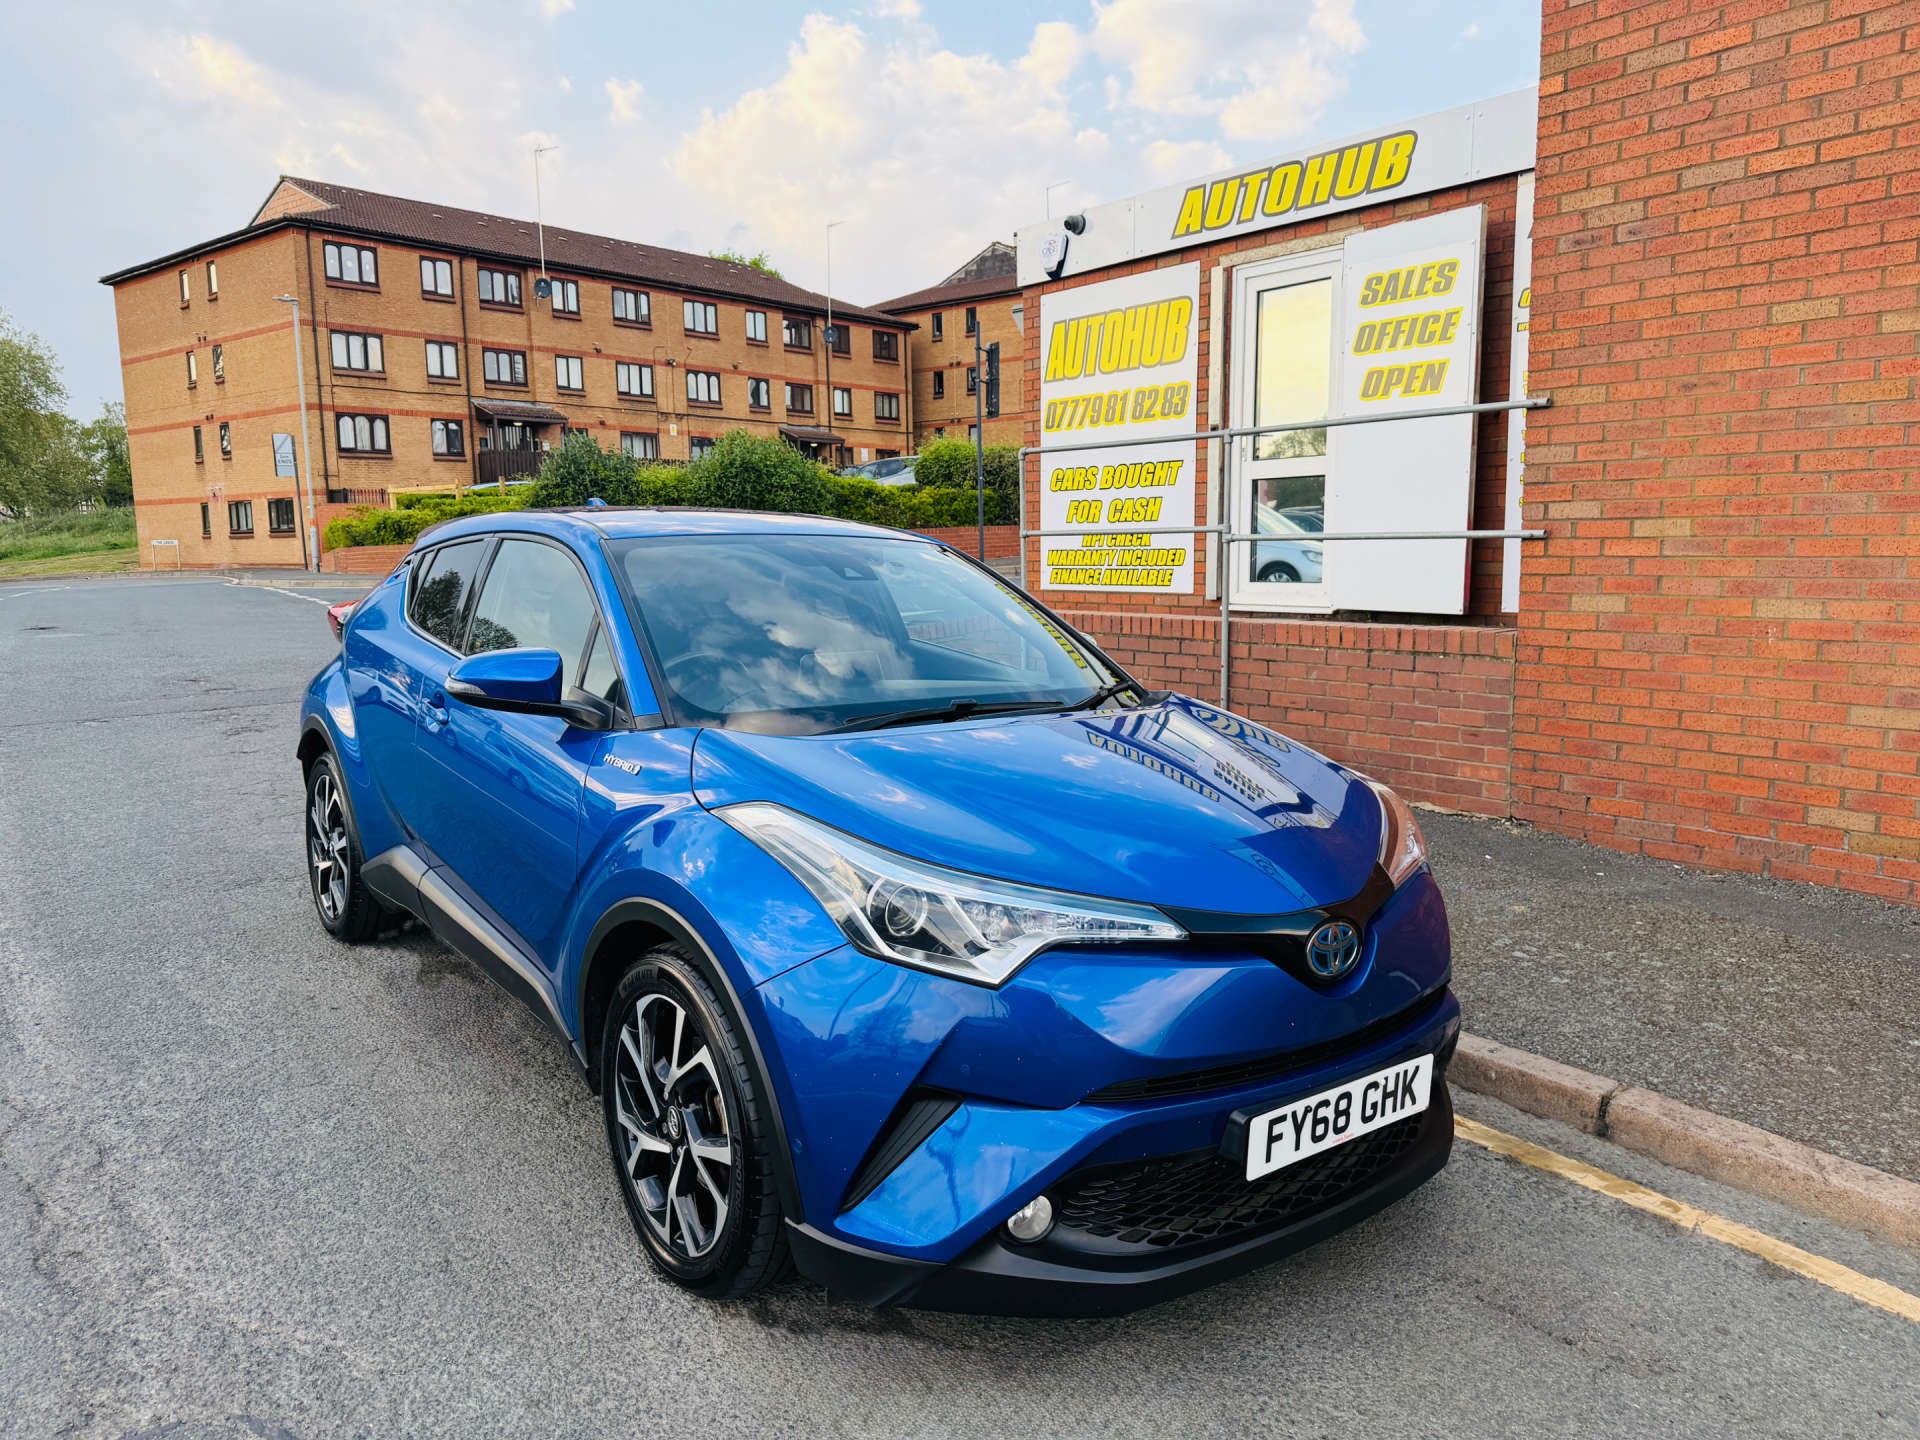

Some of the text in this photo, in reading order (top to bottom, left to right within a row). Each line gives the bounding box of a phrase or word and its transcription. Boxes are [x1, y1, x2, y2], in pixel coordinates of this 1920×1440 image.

[1171, 130, 1418, 239] AUTOHUB
[1358, 257, 1460, 308] SALES
[1044, 296, 1193, 383] AUTOHUB
[1352, 306, 1464, 356] OFFICE
[1360, 358, 1451, 402] OPEN
[1050, 460, 1184, 492] CARS BOUGHT
[1066, 496, 1163, 523] FOR CASH
[1047, 548, 1186, 566] WARRANTY INCLUDED
[1049, 568, 1174, 586] FINANCE AVAILABLE
[603, 753, 634, 773] HYBRID
[1265, 1065, 1421, 1164] FY68 GHK
